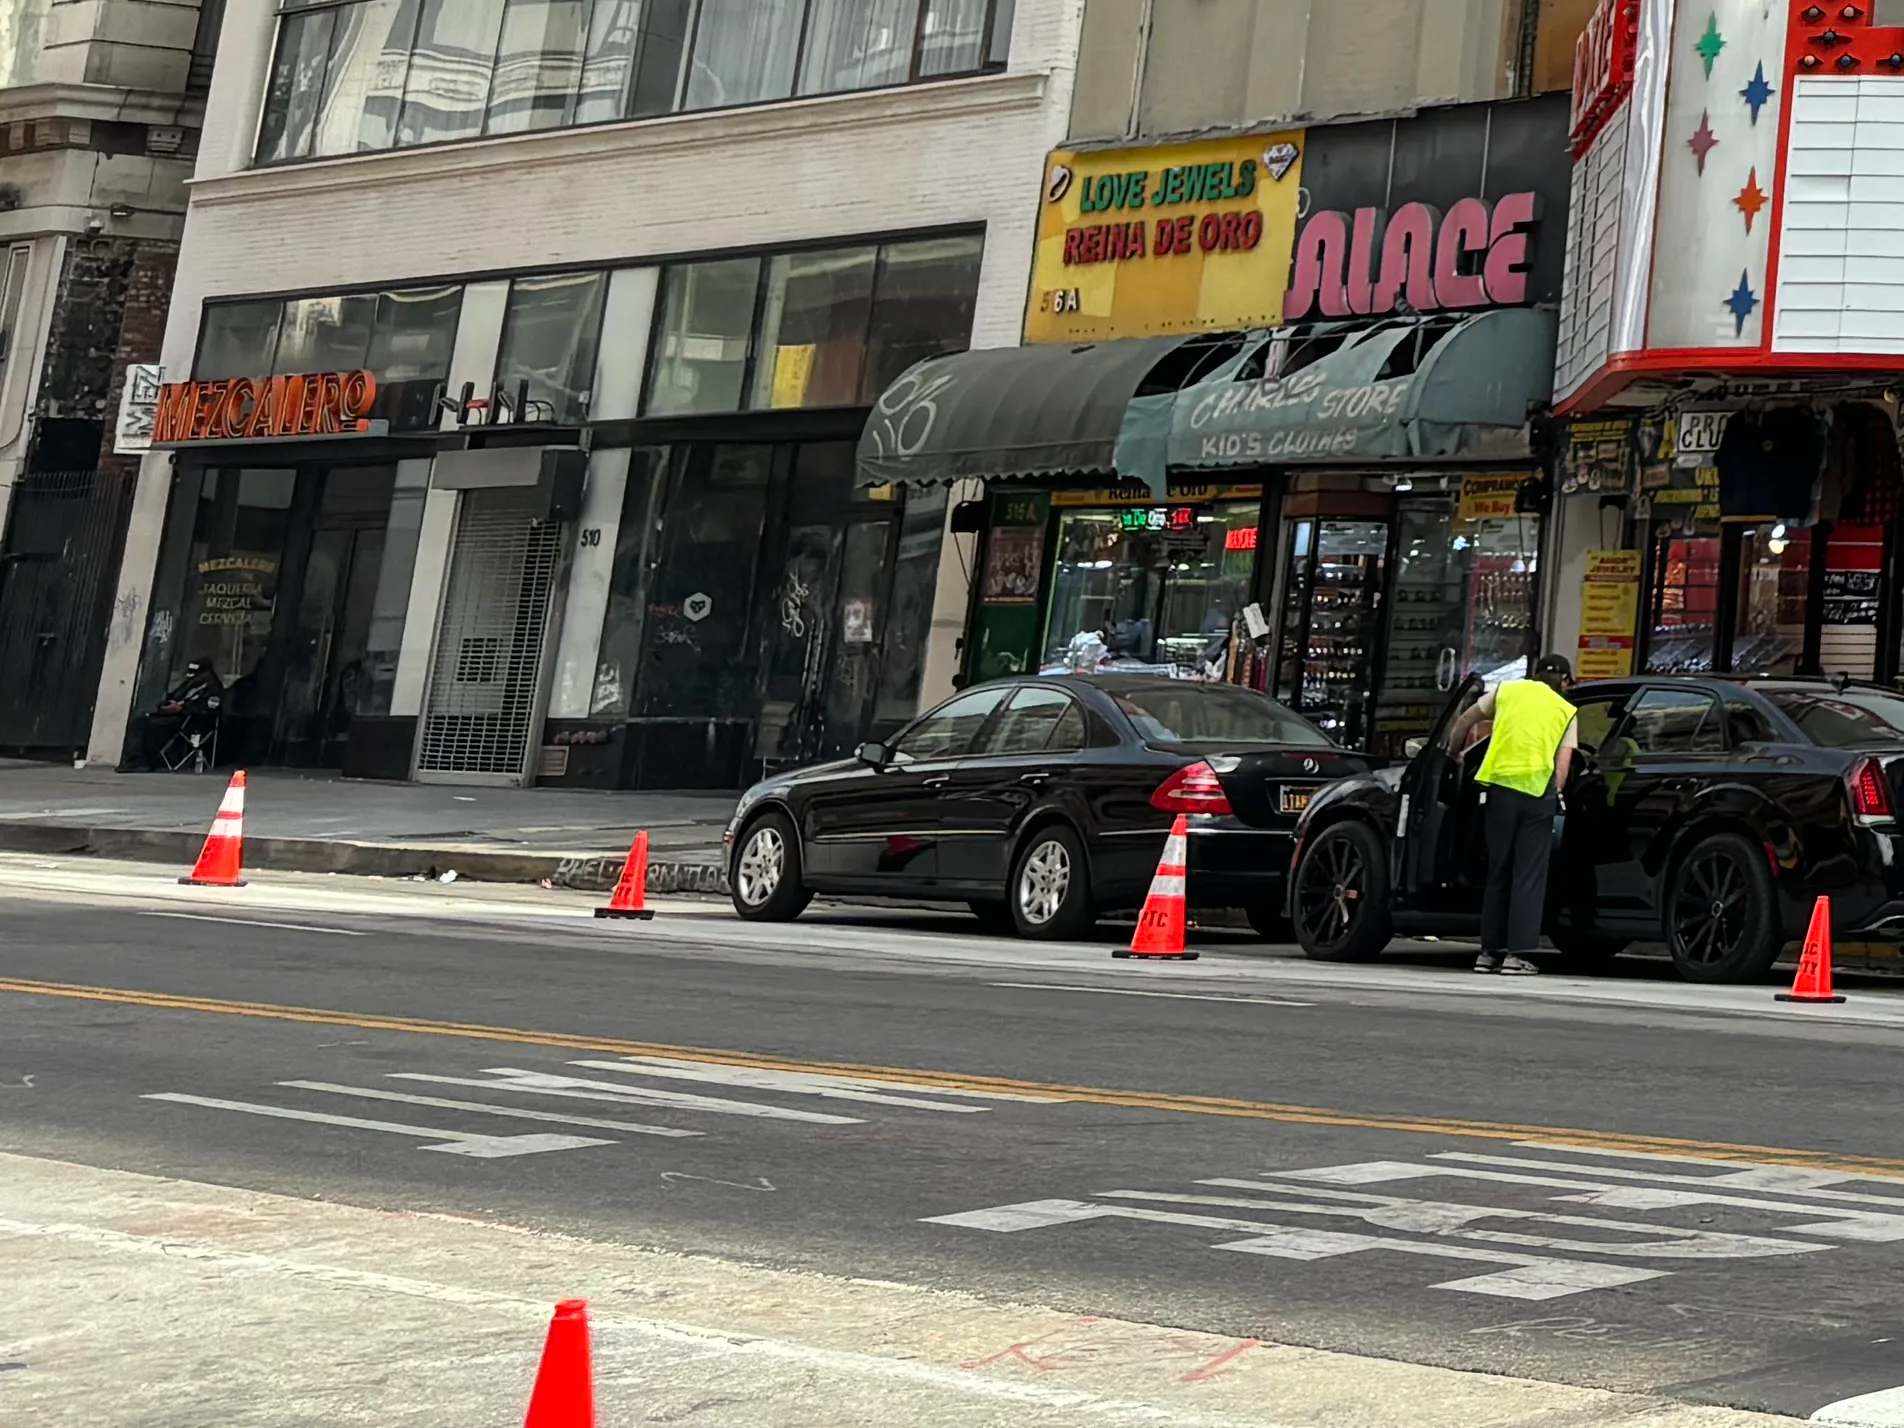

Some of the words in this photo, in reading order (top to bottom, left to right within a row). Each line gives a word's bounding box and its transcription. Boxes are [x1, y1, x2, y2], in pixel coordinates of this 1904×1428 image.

[1080, 170, 1149, 214] LOVE
[1150, 159, 1258, 208] JEWELS
[1063, 220, 1146, 265] REINA
[1153, 214, 1196, 256] DE
[1199, 209, 1264, 252] ORO
[154, 368, 377, 442] MEZCALERO
[1316, 383, 1408, 421] STORE
[1201, 431, 1261, 459] KID'S
[580, 528, 601, 547] 510
[139, 1055, 1074, 1159] WAIT
